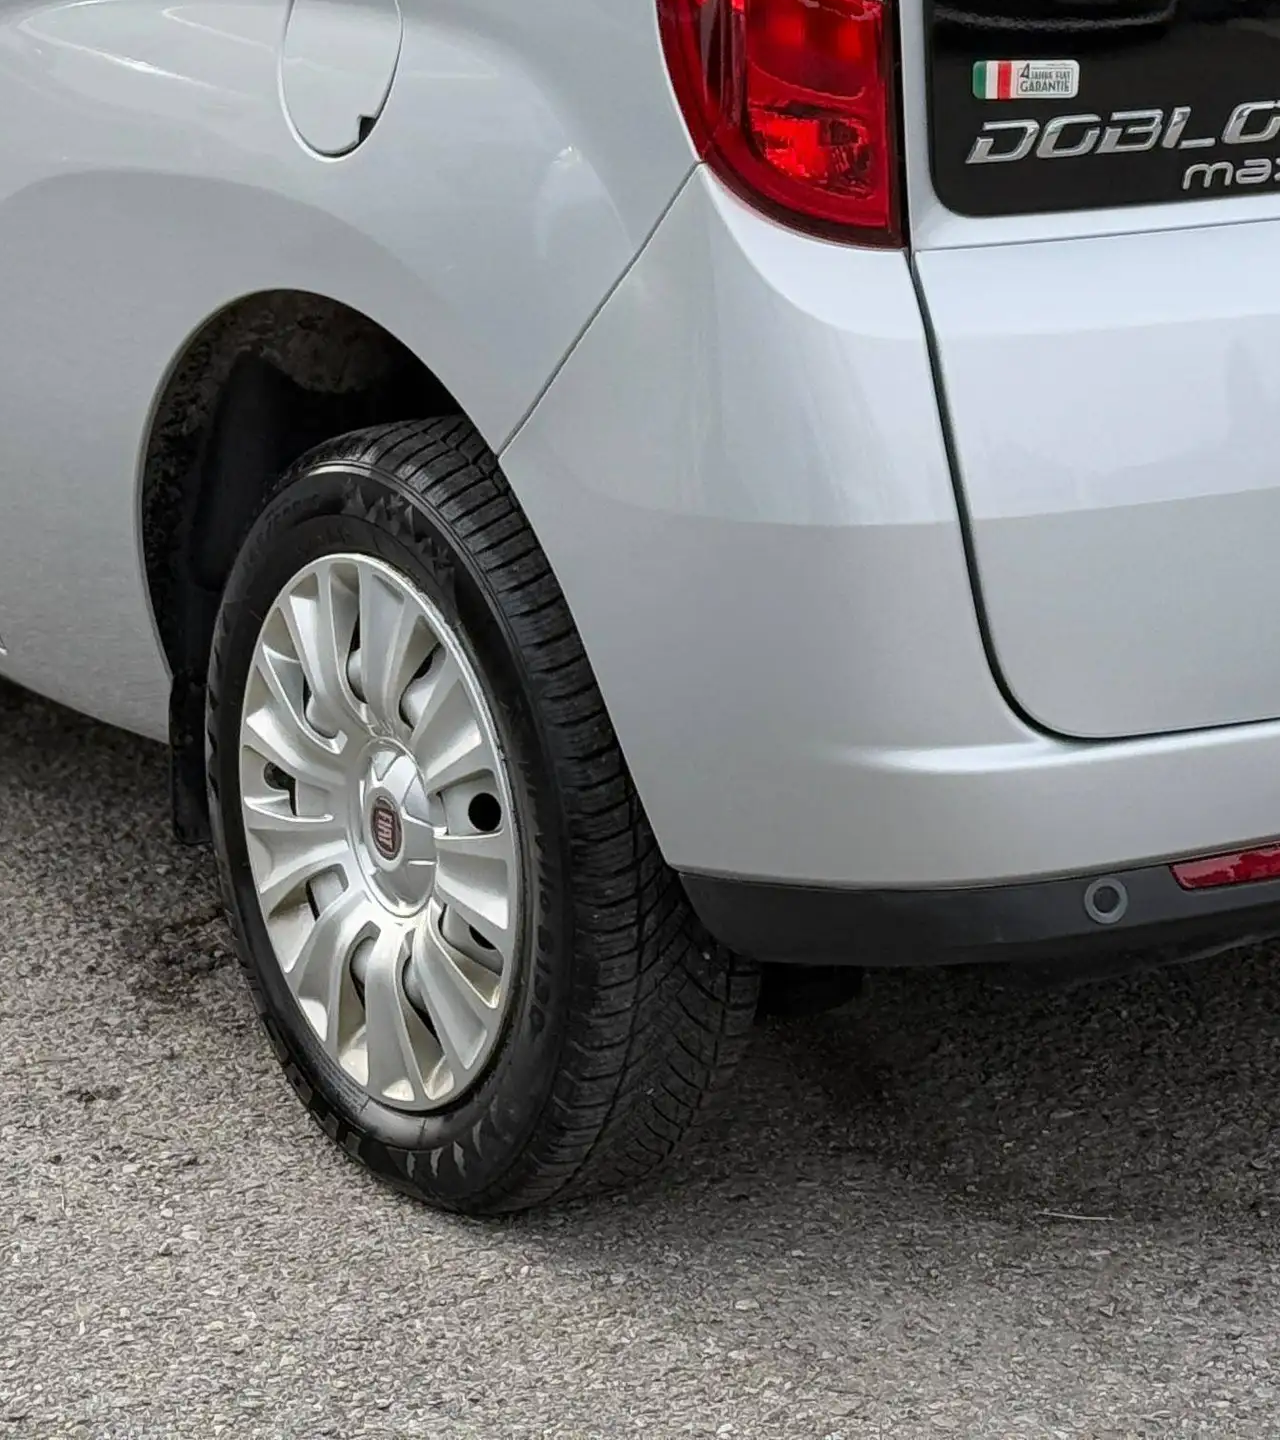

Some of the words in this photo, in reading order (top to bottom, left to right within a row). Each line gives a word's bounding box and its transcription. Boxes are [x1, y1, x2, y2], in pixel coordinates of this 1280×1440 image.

[1020, 62, 1031, 79] 4
[1055, 70, 1071, 80] FIAT
[1020, 80, 1070, 93] GARANTIE
[377, 809, 394, 850] FIAT
